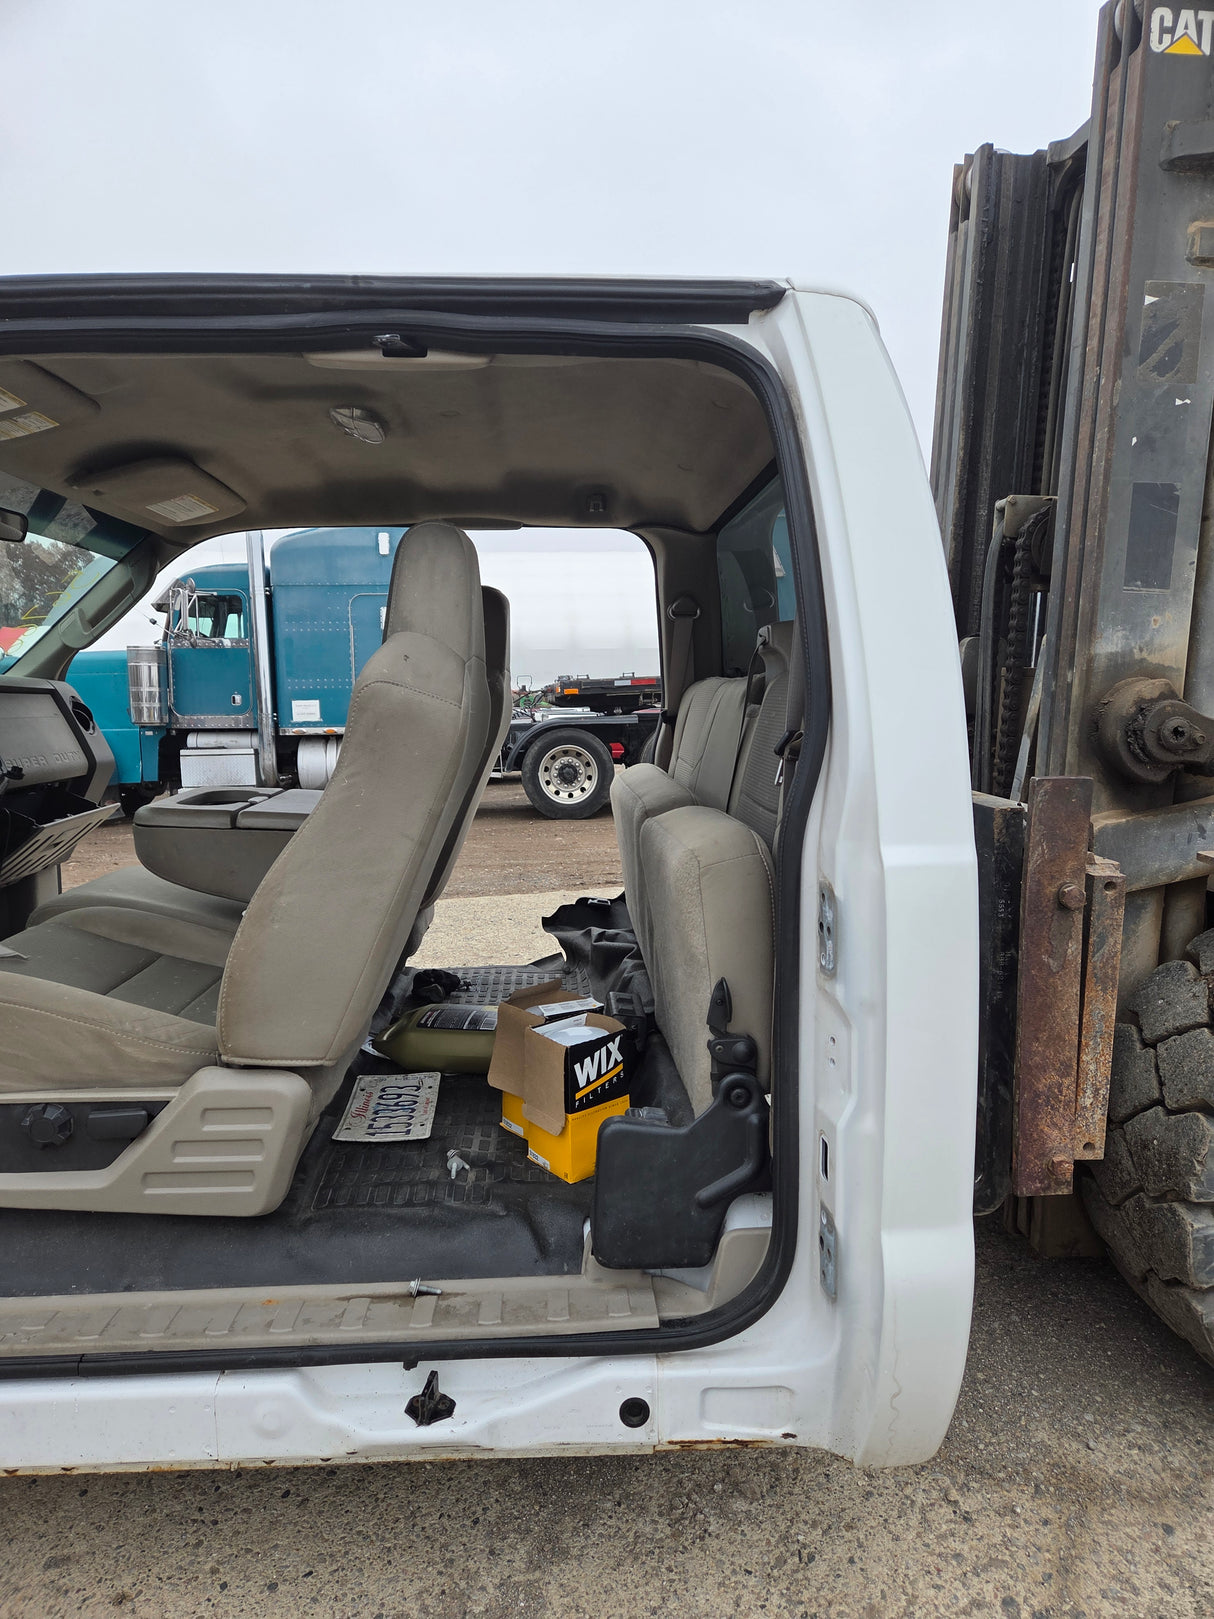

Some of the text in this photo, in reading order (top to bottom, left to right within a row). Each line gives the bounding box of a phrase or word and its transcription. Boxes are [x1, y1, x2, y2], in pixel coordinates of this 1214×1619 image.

[1149, 6, 1214, 56] CAT
[4, 754, 49, 770] SUPER
[573, 1035, 624, 1089] WIX
[350, 1090, 374, 1120] Illinois
[365, 1085, 422, 1137] 1533693
[575, 1071, 625, 1109] FILTERS
